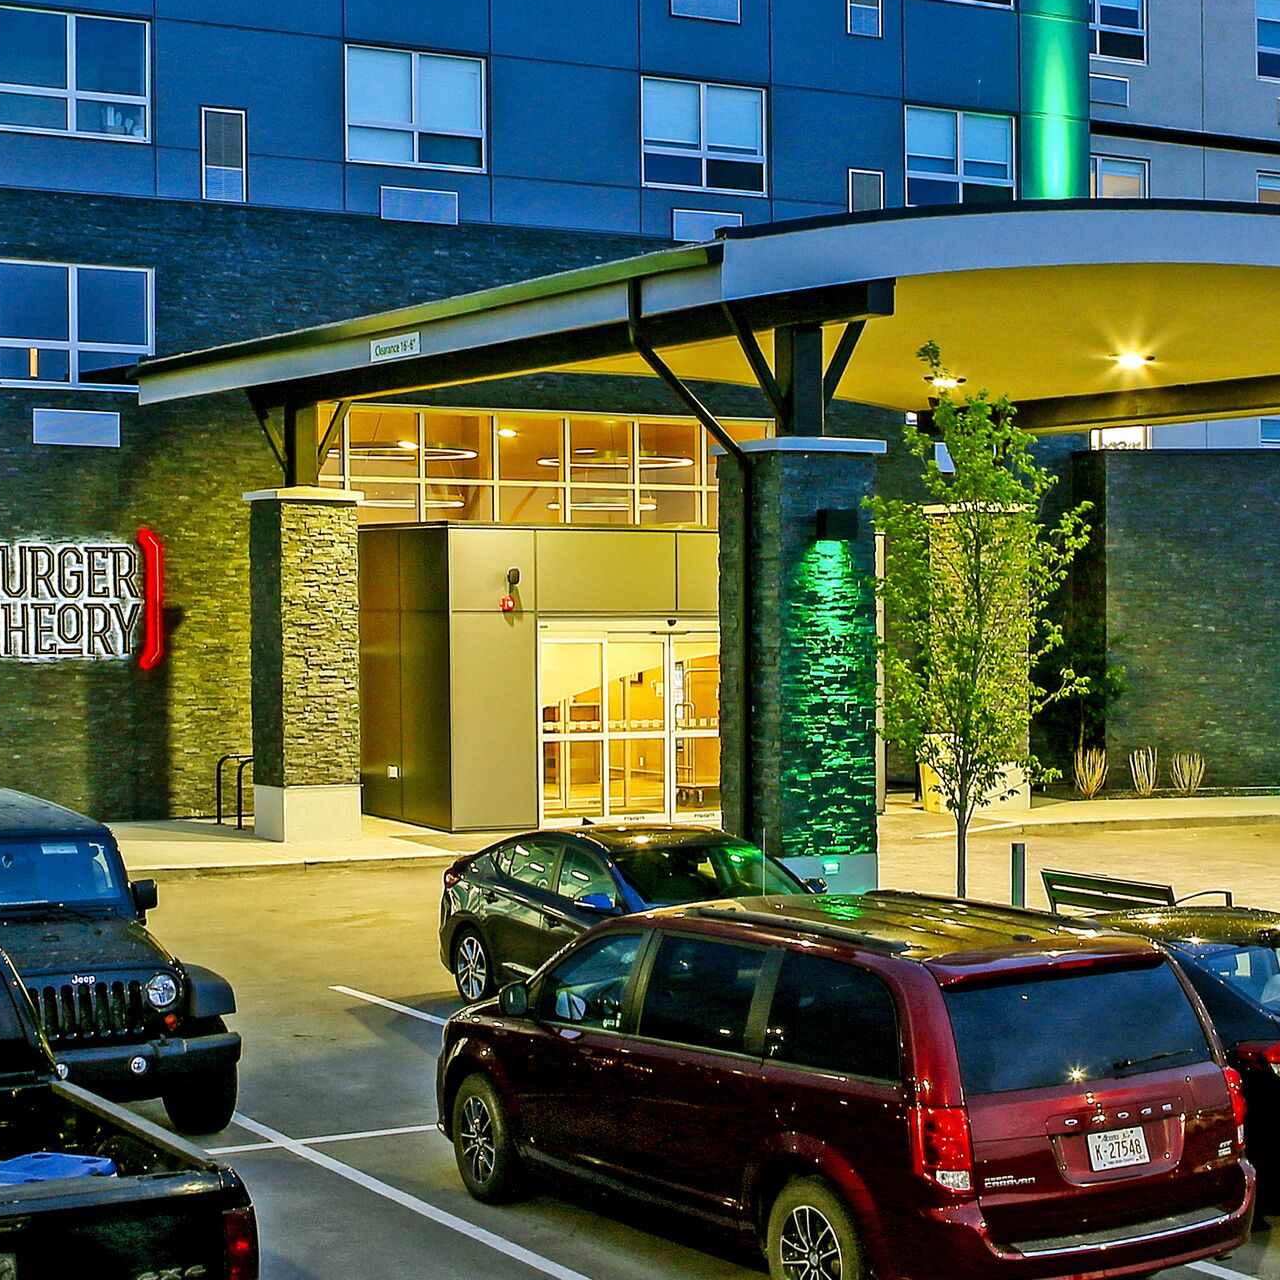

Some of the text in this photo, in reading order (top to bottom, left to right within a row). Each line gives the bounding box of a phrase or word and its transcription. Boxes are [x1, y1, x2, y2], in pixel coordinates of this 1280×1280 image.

[375, 344, 399, 356] Clearance
[71, 973, 97, 986] Jeep
[1095, 1138, 1143, 1162] K-27548
[984, 1176, 1036, 1189] CARAVAN
